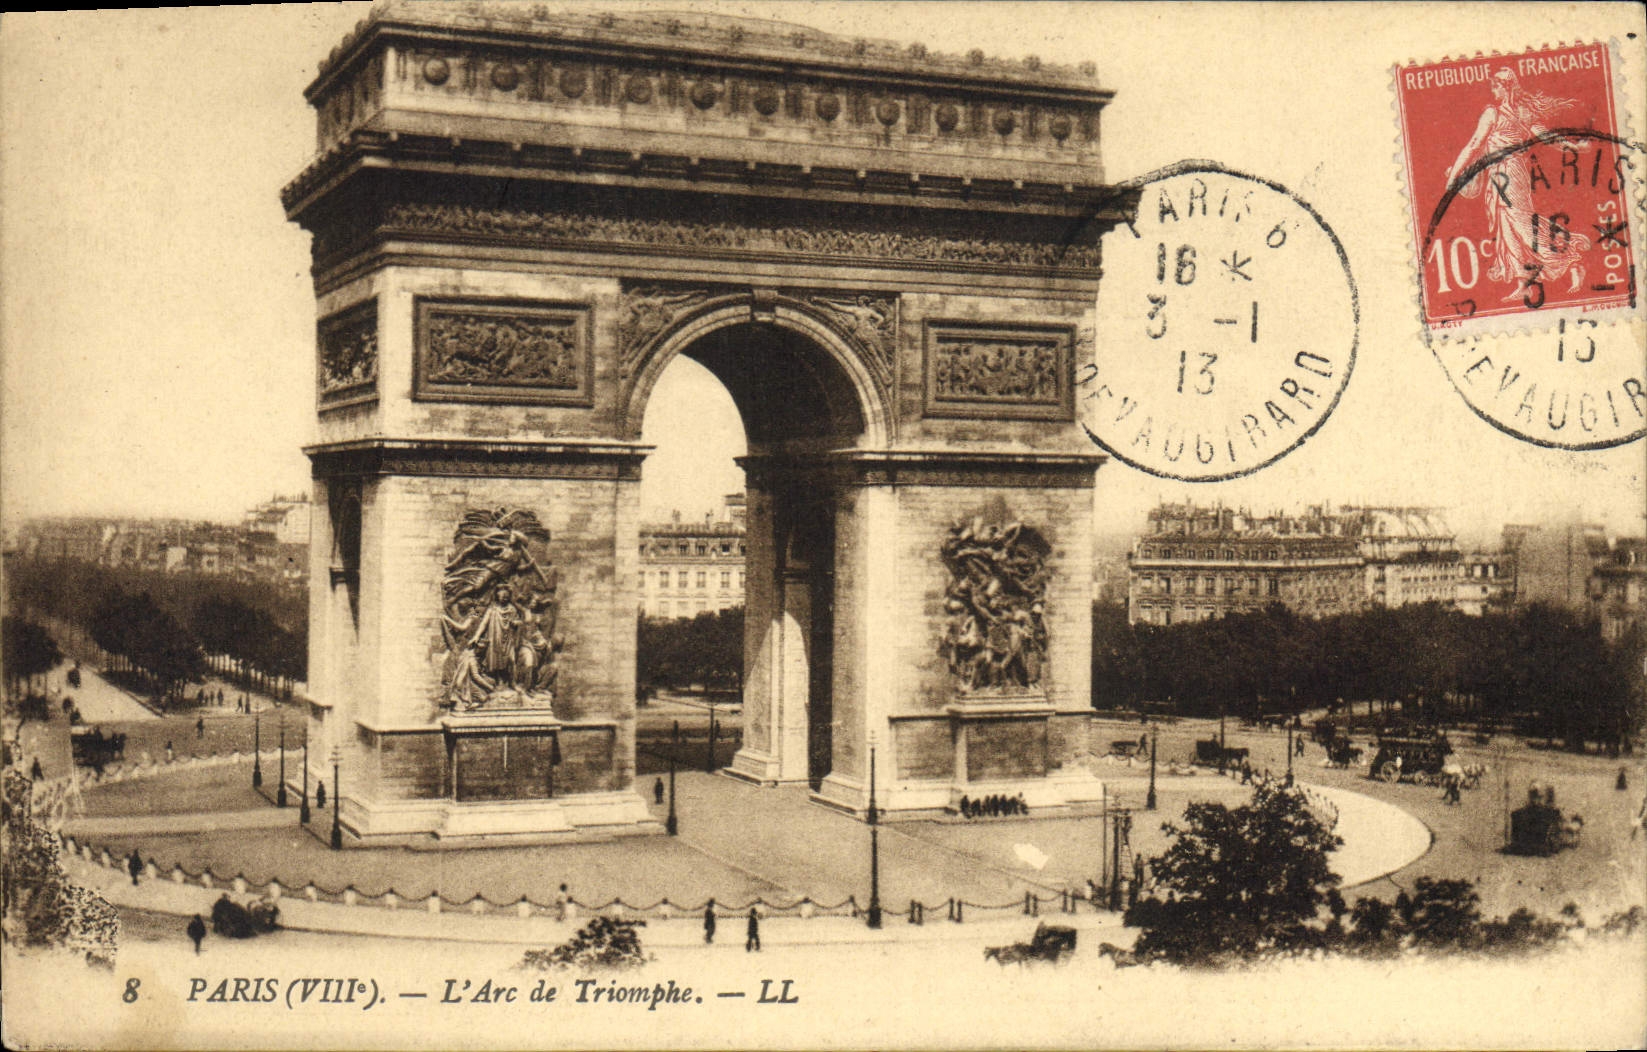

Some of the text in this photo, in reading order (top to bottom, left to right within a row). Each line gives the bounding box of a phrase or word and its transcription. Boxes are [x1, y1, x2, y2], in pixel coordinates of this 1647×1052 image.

[1405, 49, 1600, 91] REPUBLIQUE FRANÇAISE
[1492, 146, 1635, 209] PARIS
[1157, 242, 1197, 286] 16
[1146, 293, 1168, 340] 3
[1176, 350, 1218, 395] 13
